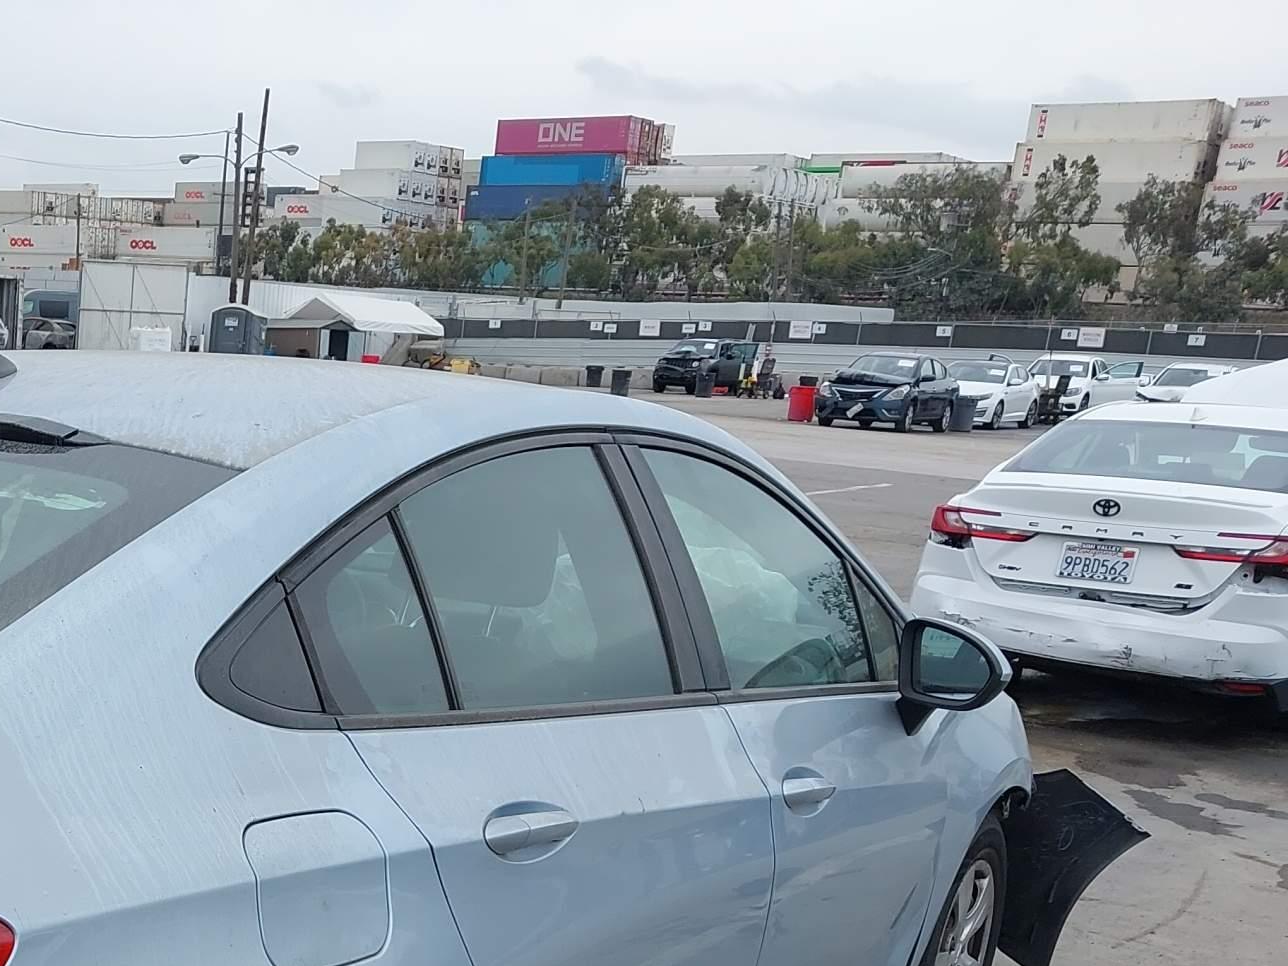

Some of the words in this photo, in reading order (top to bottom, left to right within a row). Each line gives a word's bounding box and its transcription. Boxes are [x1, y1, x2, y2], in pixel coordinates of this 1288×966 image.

[537, 122, 585, 142] ONE
[287, 205, 309, 213] OOCL
[10, 238, 34, 247] OOCL
[130, 239, 156, 249] OOCL
[1029, 521, 1184, 540] CAMRY
[1063, 556, 1130, 576] 9PBD562
[1063, 572, 1128, 582] TOYOTA
